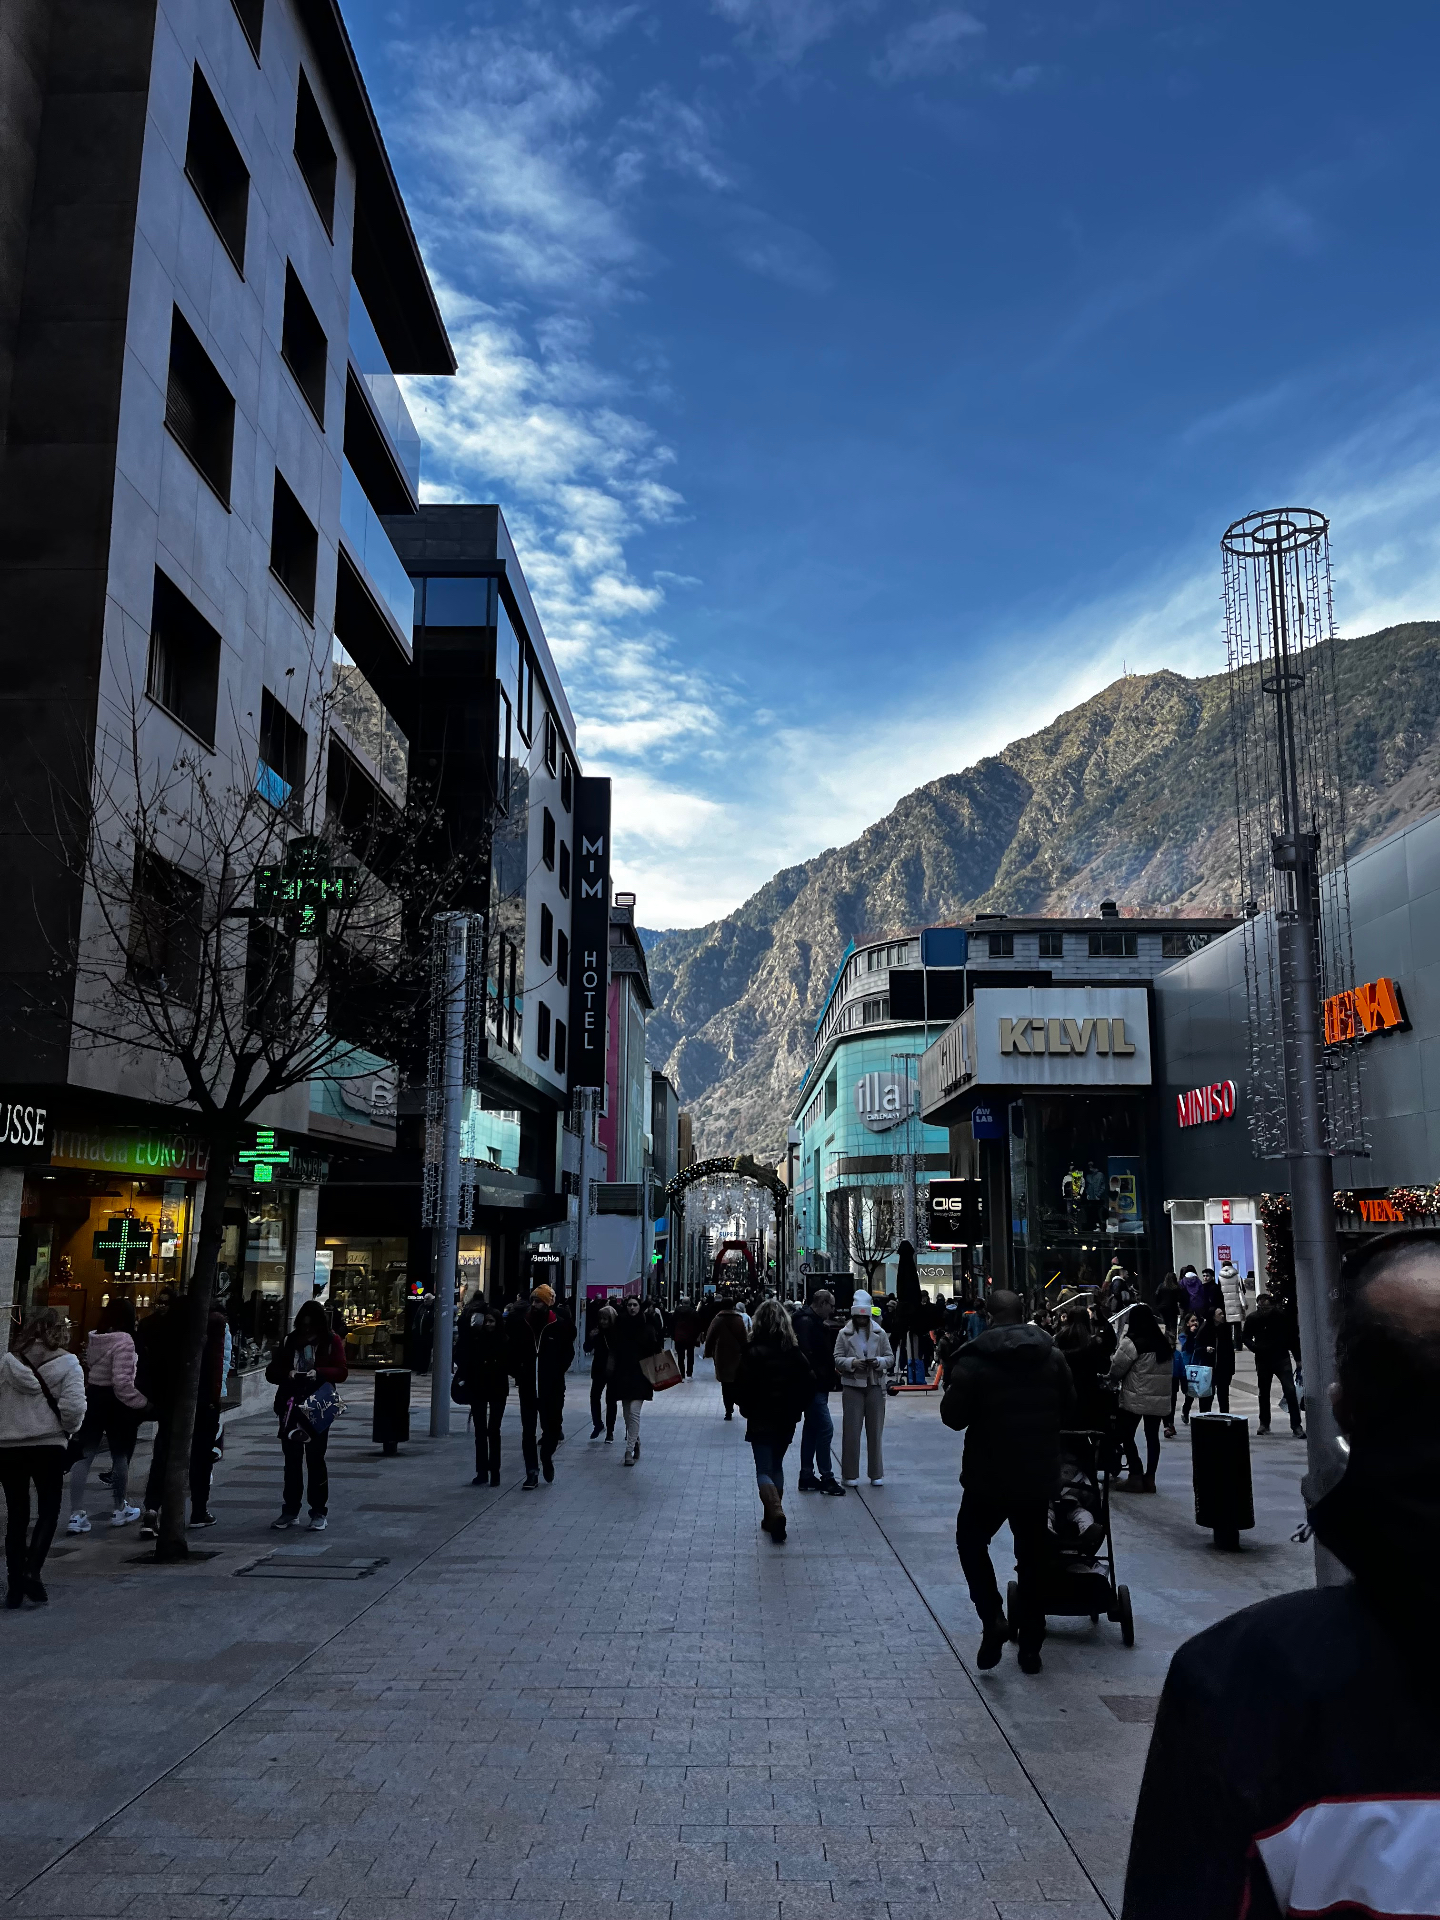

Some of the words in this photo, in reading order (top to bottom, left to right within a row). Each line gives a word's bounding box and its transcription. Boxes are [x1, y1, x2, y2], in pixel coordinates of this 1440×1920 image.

[581, 834, 604, 899] MIM
[582, 950, 598, 1050] HOTEL
[858, 1071, 901, 1113] illa
[976, 1107, 991, 1115] AW
[1177, 1080, 1237, 1128] MINISO
[975, 1115, 993, 1123] LAB
[530, 1254, 560, 1263] Bershka
